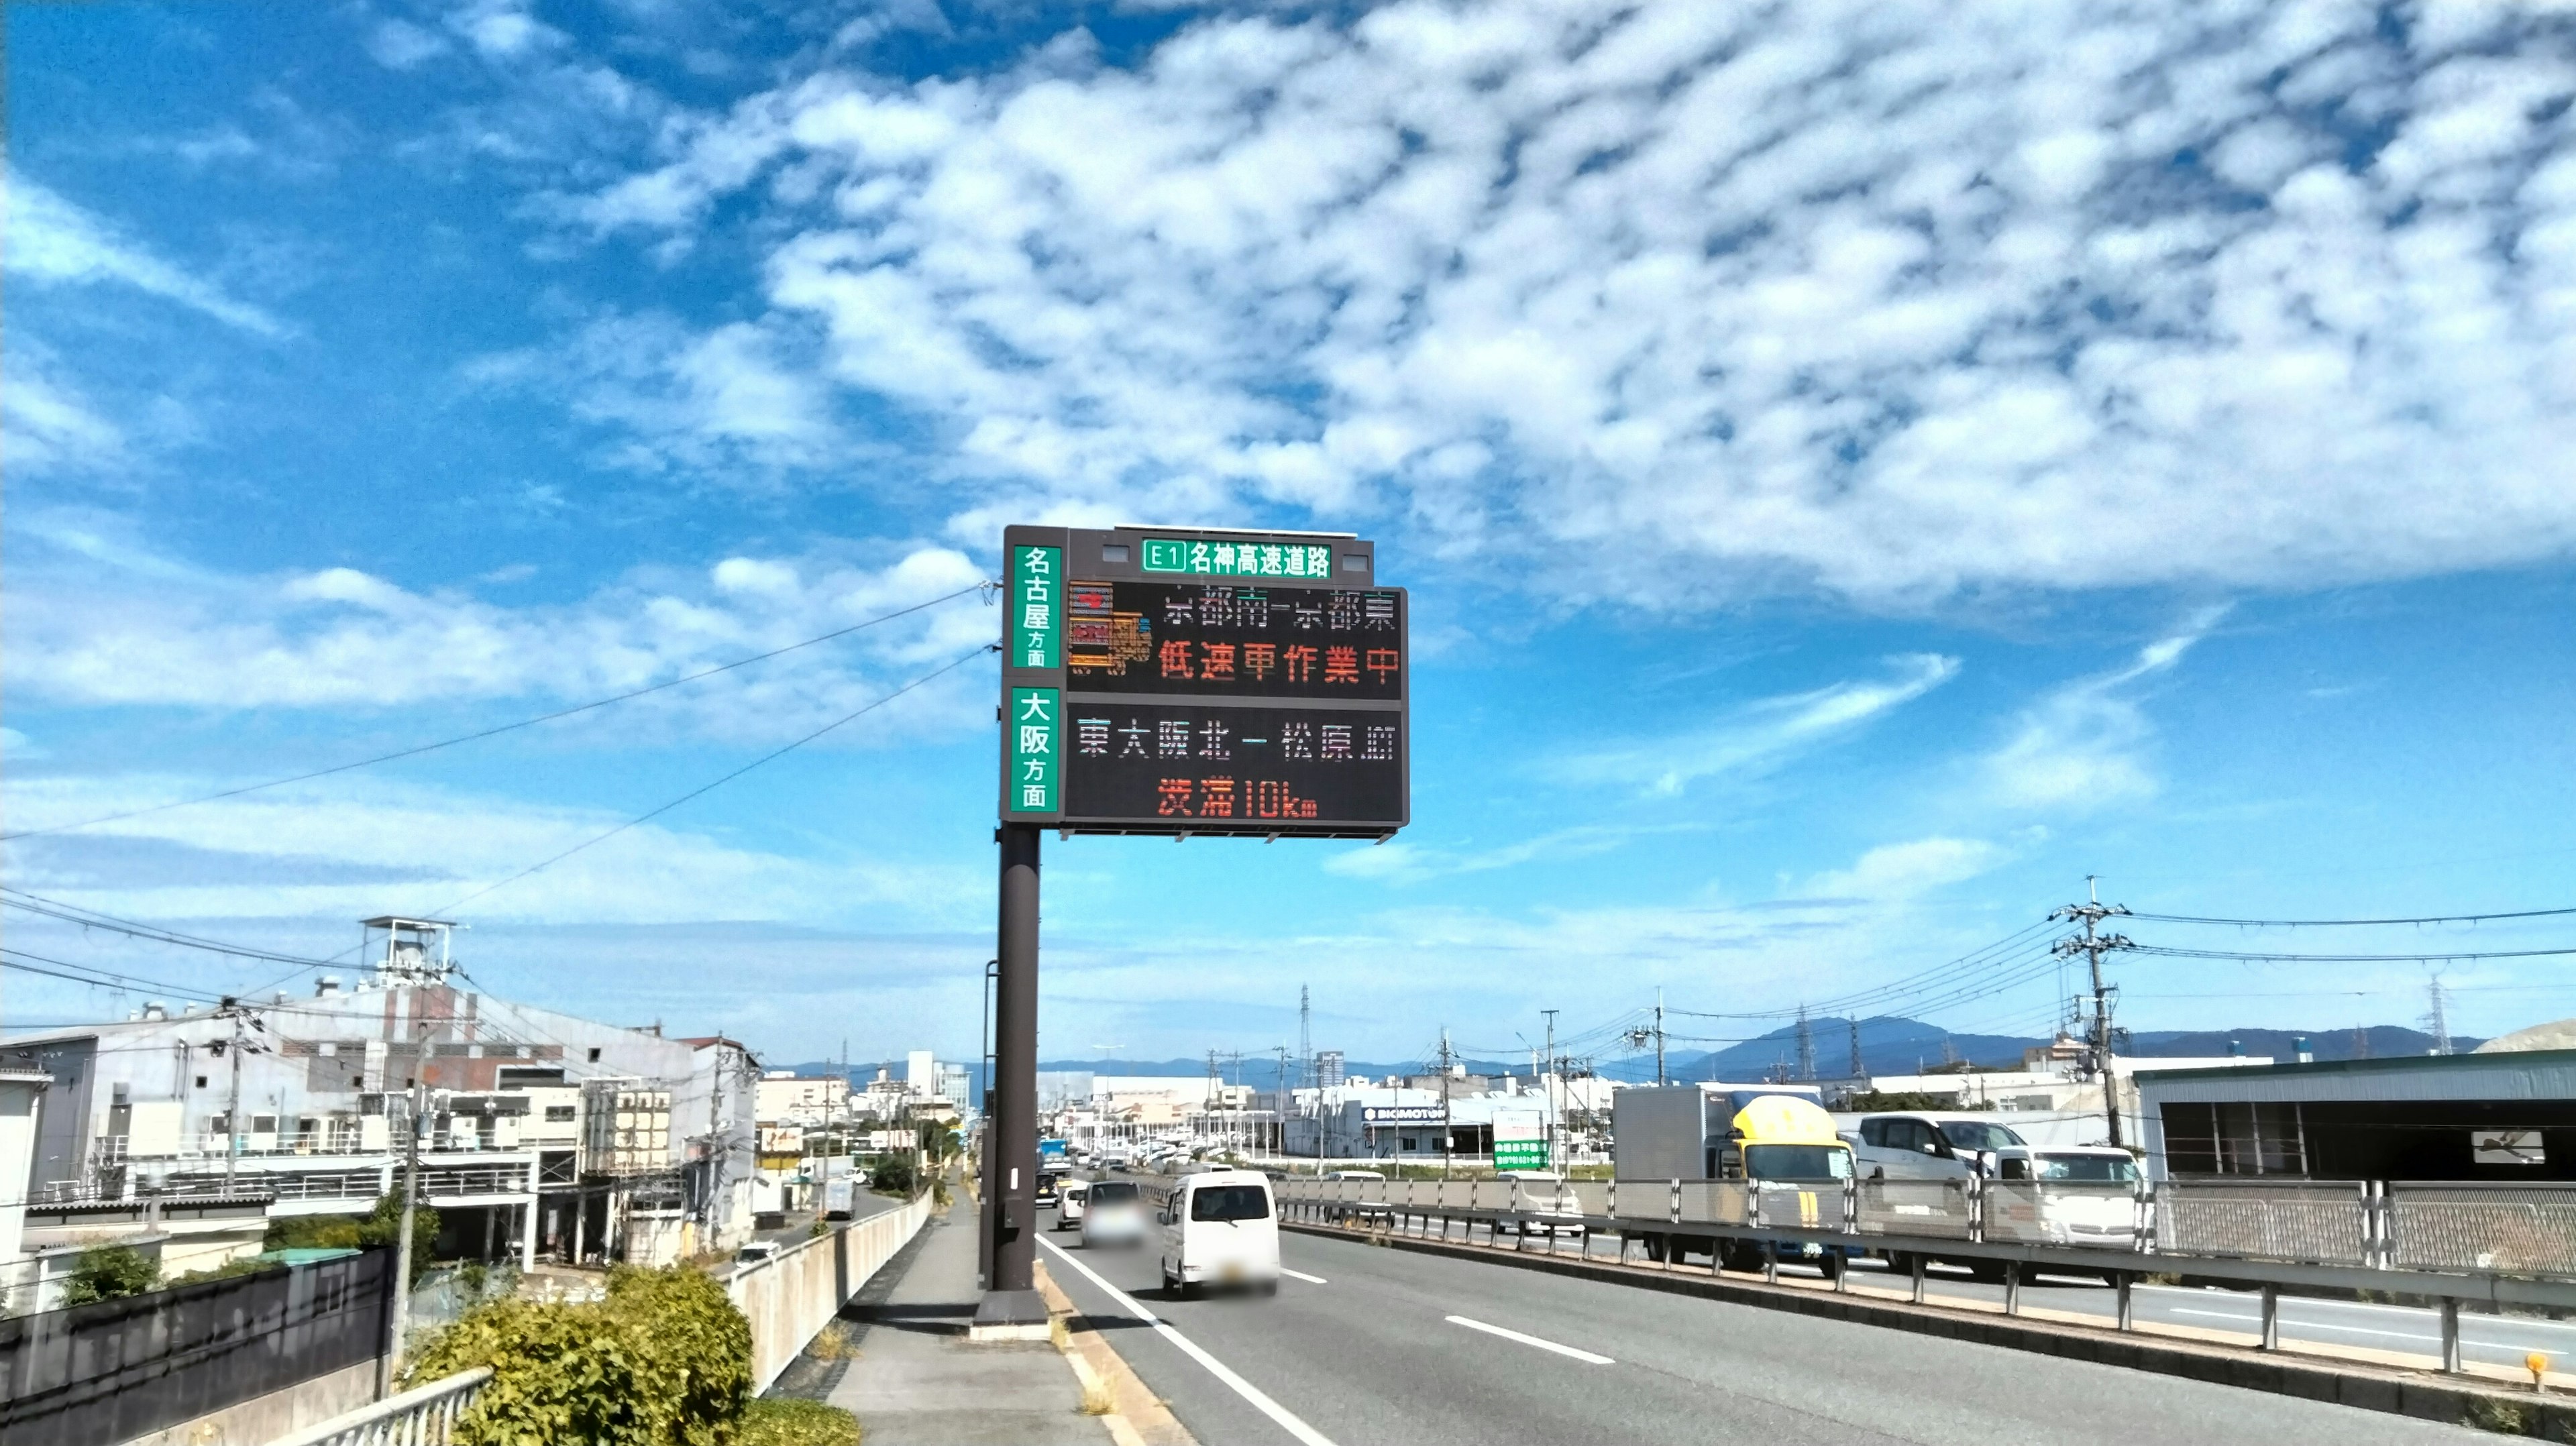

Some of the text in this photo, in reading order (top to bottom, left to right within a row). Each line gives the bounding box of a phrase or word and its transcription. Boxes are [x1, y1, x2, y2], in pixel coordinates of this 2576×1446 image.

[1152, 546, 1177, 565] E1
[1189, 542, 1329, 577] 名神高速道路
[1024, 547, 1051, 667] 名古屋方面
[1159, 641, 1399, 684] 低速車作業中
[1020, 692, 1051, 807] 大阪方面
